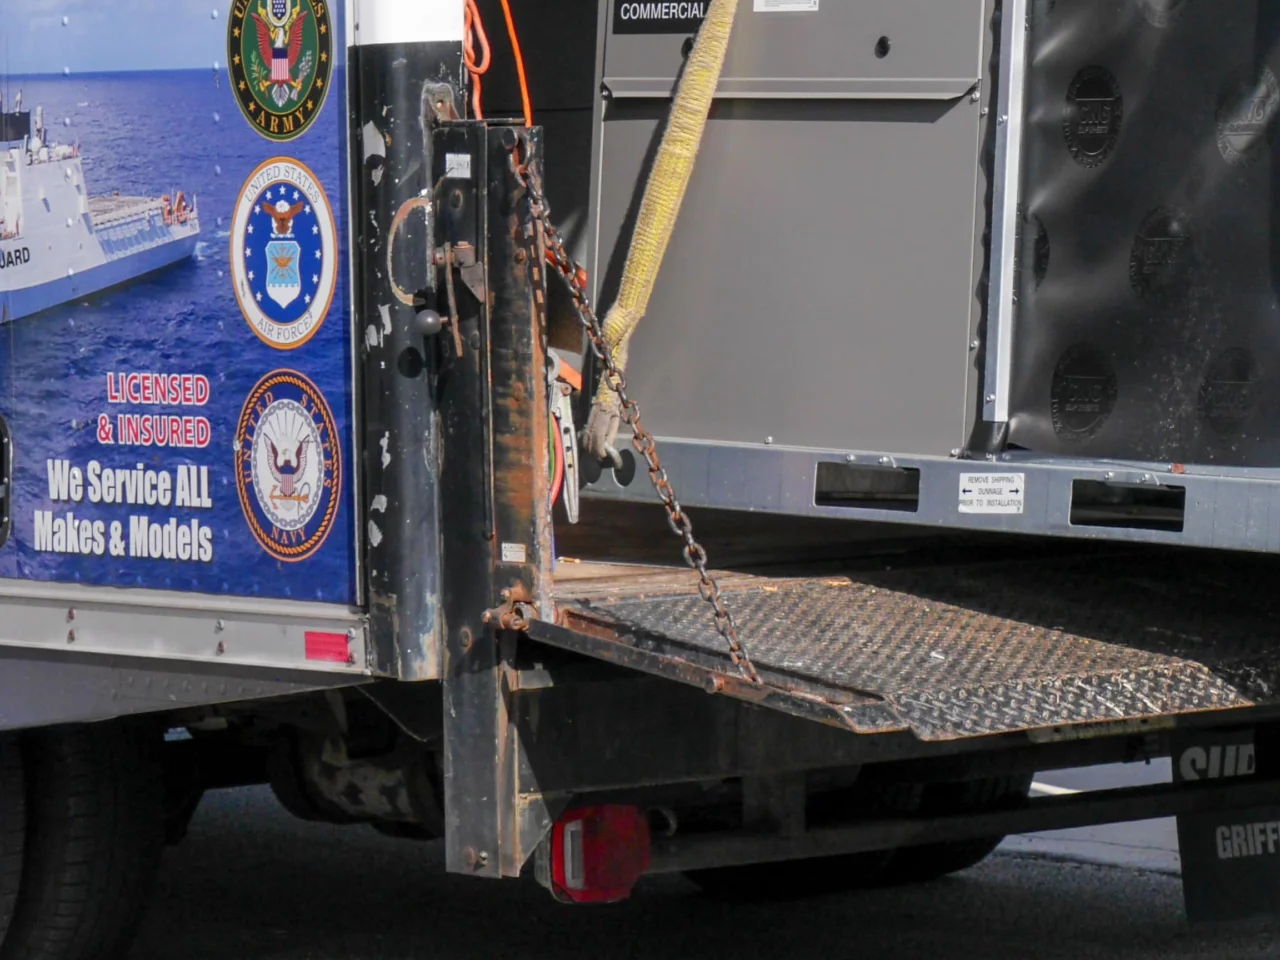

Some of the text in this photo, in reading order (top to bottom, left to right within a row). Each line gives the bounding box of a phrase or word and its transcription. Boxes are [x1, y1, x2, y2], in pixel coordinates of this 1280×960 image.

[620, 1, 705, 21] COMMERCIAL
[256, 108, 306, 134] ARMY
[244, 165, 321, 204] UNITED STATES
[0, 246, 31, 269] UARD
[256, 317, 312, 341] AIR FORCE
[107, 371, 211, 406] LICENSED
[97, 413, 212, 448] & INSURED
[243, 391, 334, 489] UNITED STATES
[47, 458, 213, 509] We Service ALL
[968, 476, 1015, 484] REMOVE SHIPPING
[978, 487, 1004, 496] DUNNAGE
[959, 499, 1022, 507] PRIOR TO INSTALLATION
[33, 509, 213, 563] Makes & Models
[271, 526, 306, 545] NAVY
